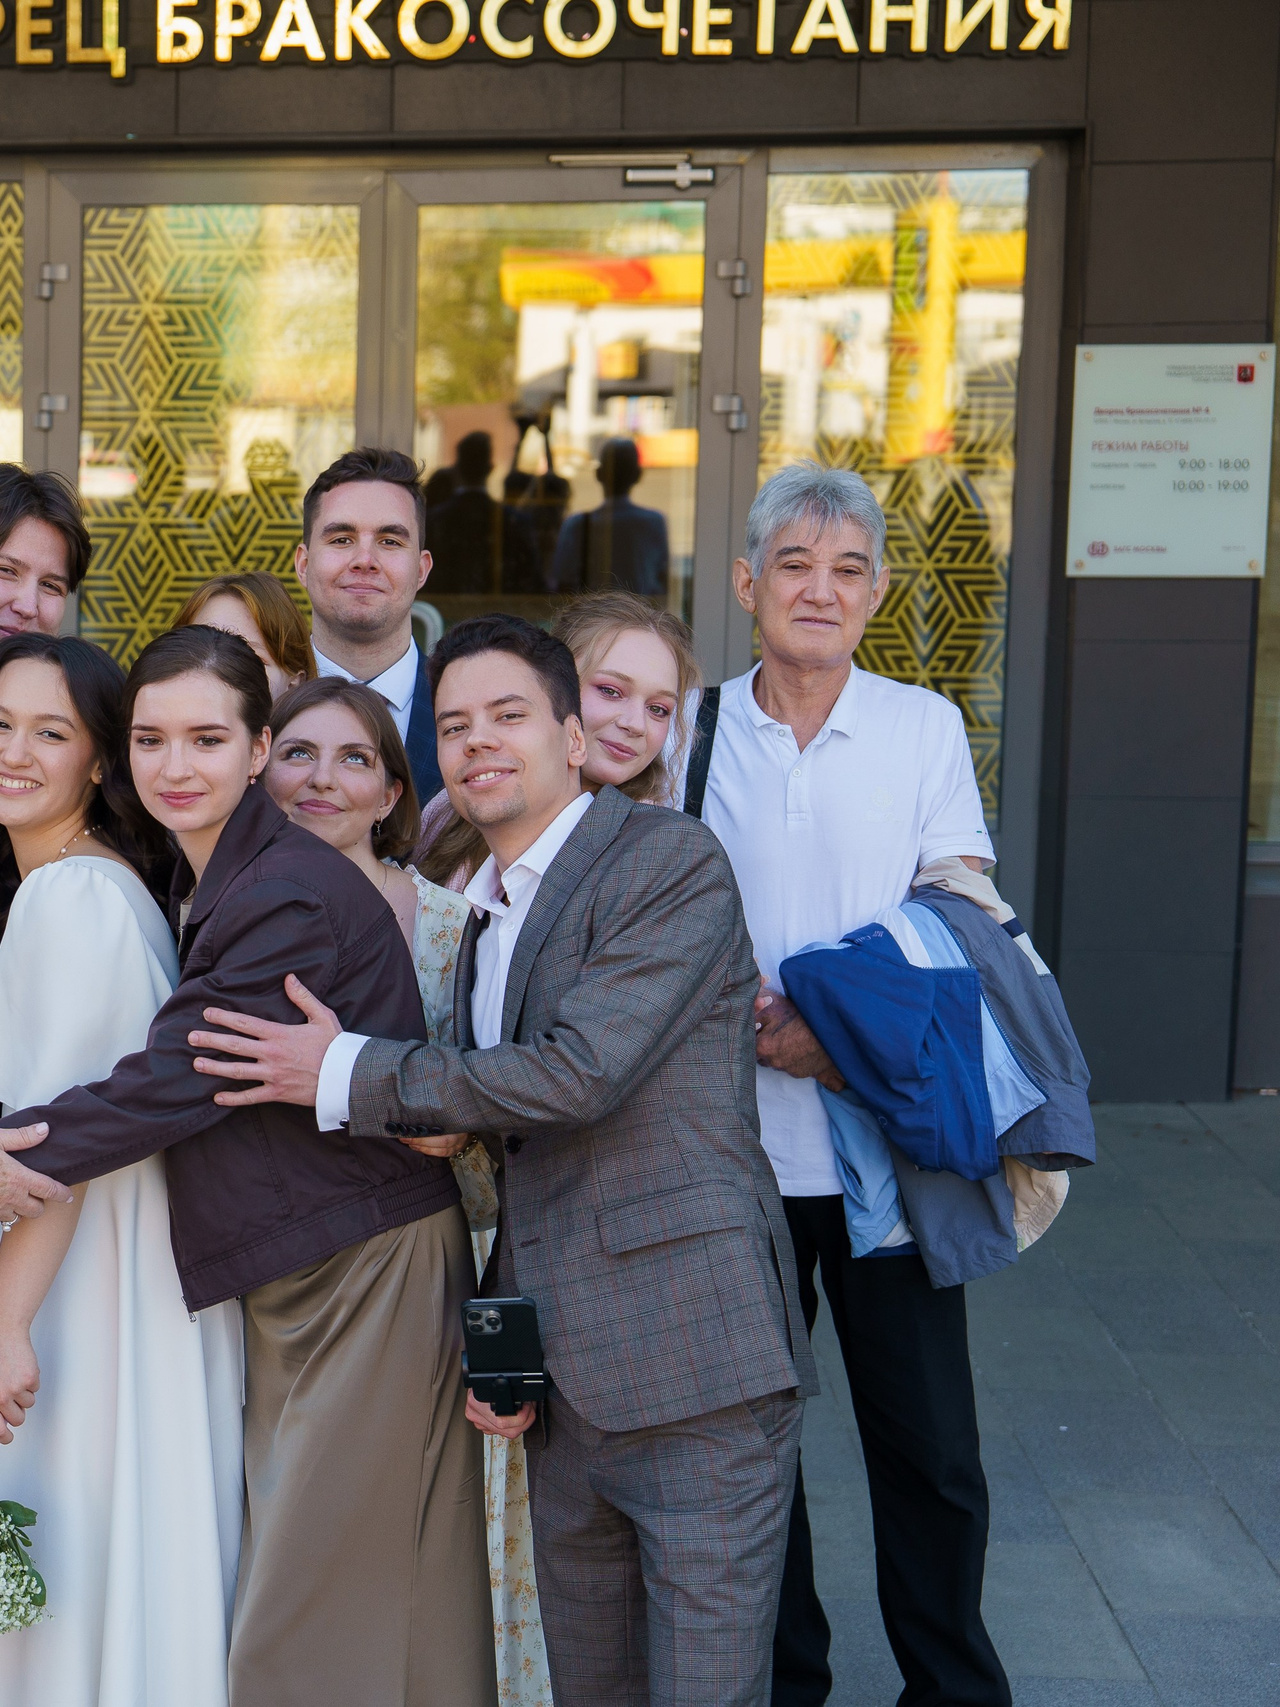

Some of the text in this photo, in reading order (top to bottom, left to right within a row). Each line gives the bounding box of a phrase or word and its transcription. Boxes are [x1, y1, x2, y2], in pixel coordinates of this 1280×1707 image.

[157, 0, 1069, 63] БРАКОСОЧЕТАНИЯ
[1091, 440, 1190, 452] РЕЖИМ РАБОТЫ
[1178, 458, 1206, 469] 9:00
[1218, 458, 1250, 469] 18:00
[1172, 479, 1205, 491] 10:00
[1217, 479, 1249, 491] 19:00
